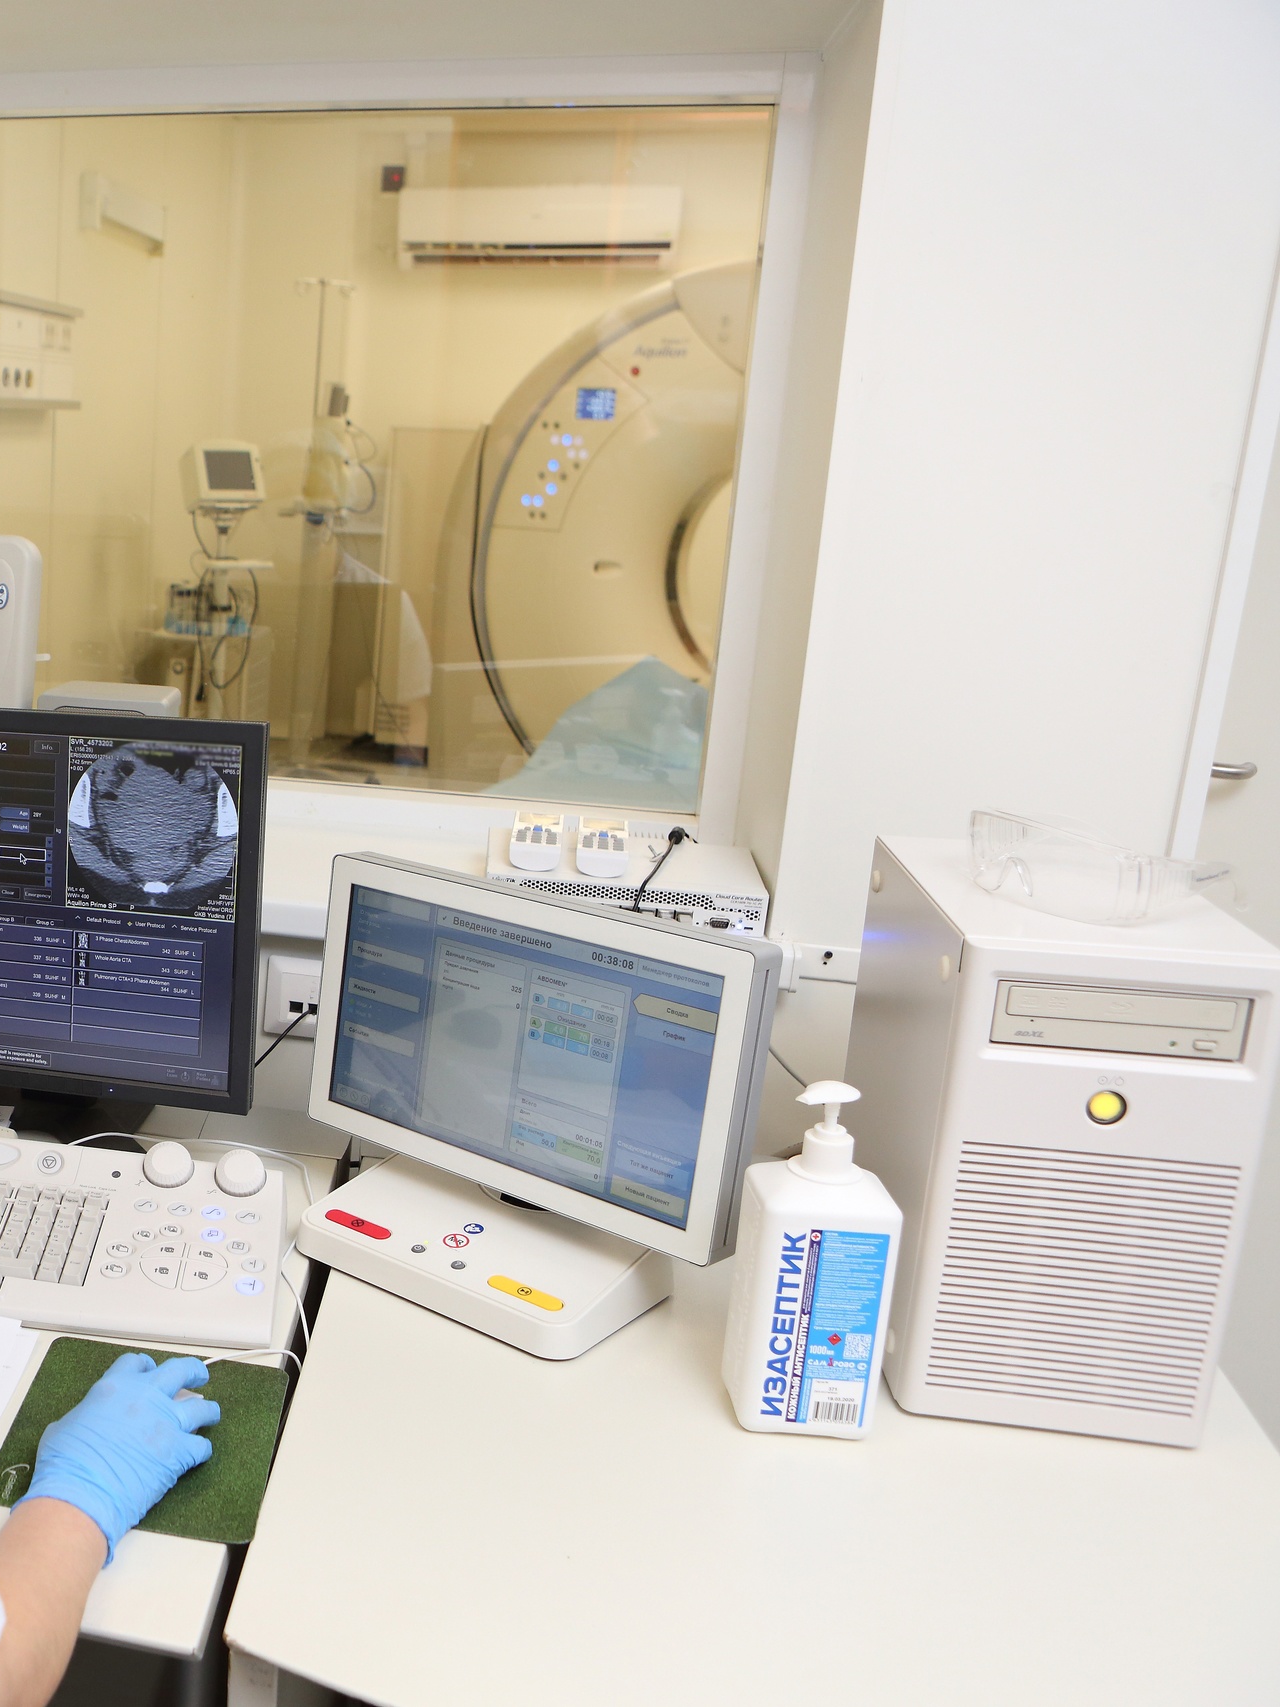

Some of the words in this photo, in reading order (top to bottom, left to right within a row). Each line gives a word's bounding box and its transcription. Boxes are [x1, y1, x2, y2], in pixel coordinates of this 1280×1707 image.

[24, 891, 51, 899] Emergency
[90, 901, 107, 909] Prime
[35, 919, 49, 927] Group
[86, 916, 104, 924] Default
[180, 925, 198, 933] Service
[198, 926, 218, 934] Protocol
[452, 916, 498, 936] Введение
[499, 930, 552, 950] завершено
[357, 946, 383, 958] Процедура
[445, 950, 465, 961] Данные
[465, 956, 496, 969] процедуры
[591, 951, 635, 971] 00:38:08
[94, 974, 117, 983] Pulmonary
[134, 977, 148, 985] Phase
[642, 964, 673, 979] Менеджер
[674, 972, 710, 988] протоколов
[353, 983, 377, 995] Жидкости
[511, 985, 522, 994] 325
[597, 1014, 615, 1024] 00:05
[666, 1007, 689, 1019] Сводка
[557, 1015, 587, 1029] Ожидание
[593, 1036, 611, 1048] 00:18
[662, 1030, 686, 1042] График
[12, 1051, 35, 1059] responsible
[592, 1048, 609, 1060] 00:08
[521, 1098, 538, 1109] Всего
[575, 1133, 604, 1149] 00:01:05
[586, 1153, 601, 1165] 70,0
[616, 1139, 653, 1157] Следующая
[653, 1151, 682, 1167] инъекция
[629, 1159, 640, 1167] Тот
[649, 1165, 675, 1180] пациент
[624, 1185, 645, 1197] Новый
[645, 1191, 671, 1207] пациент
[760, 1231, 807, 1417] ИЗАСЕПТИК
[793, 1313, 810, 1375] АНТИСЕПТИК
[787, 1374, 801, 1420] КОЖНЫЙ
